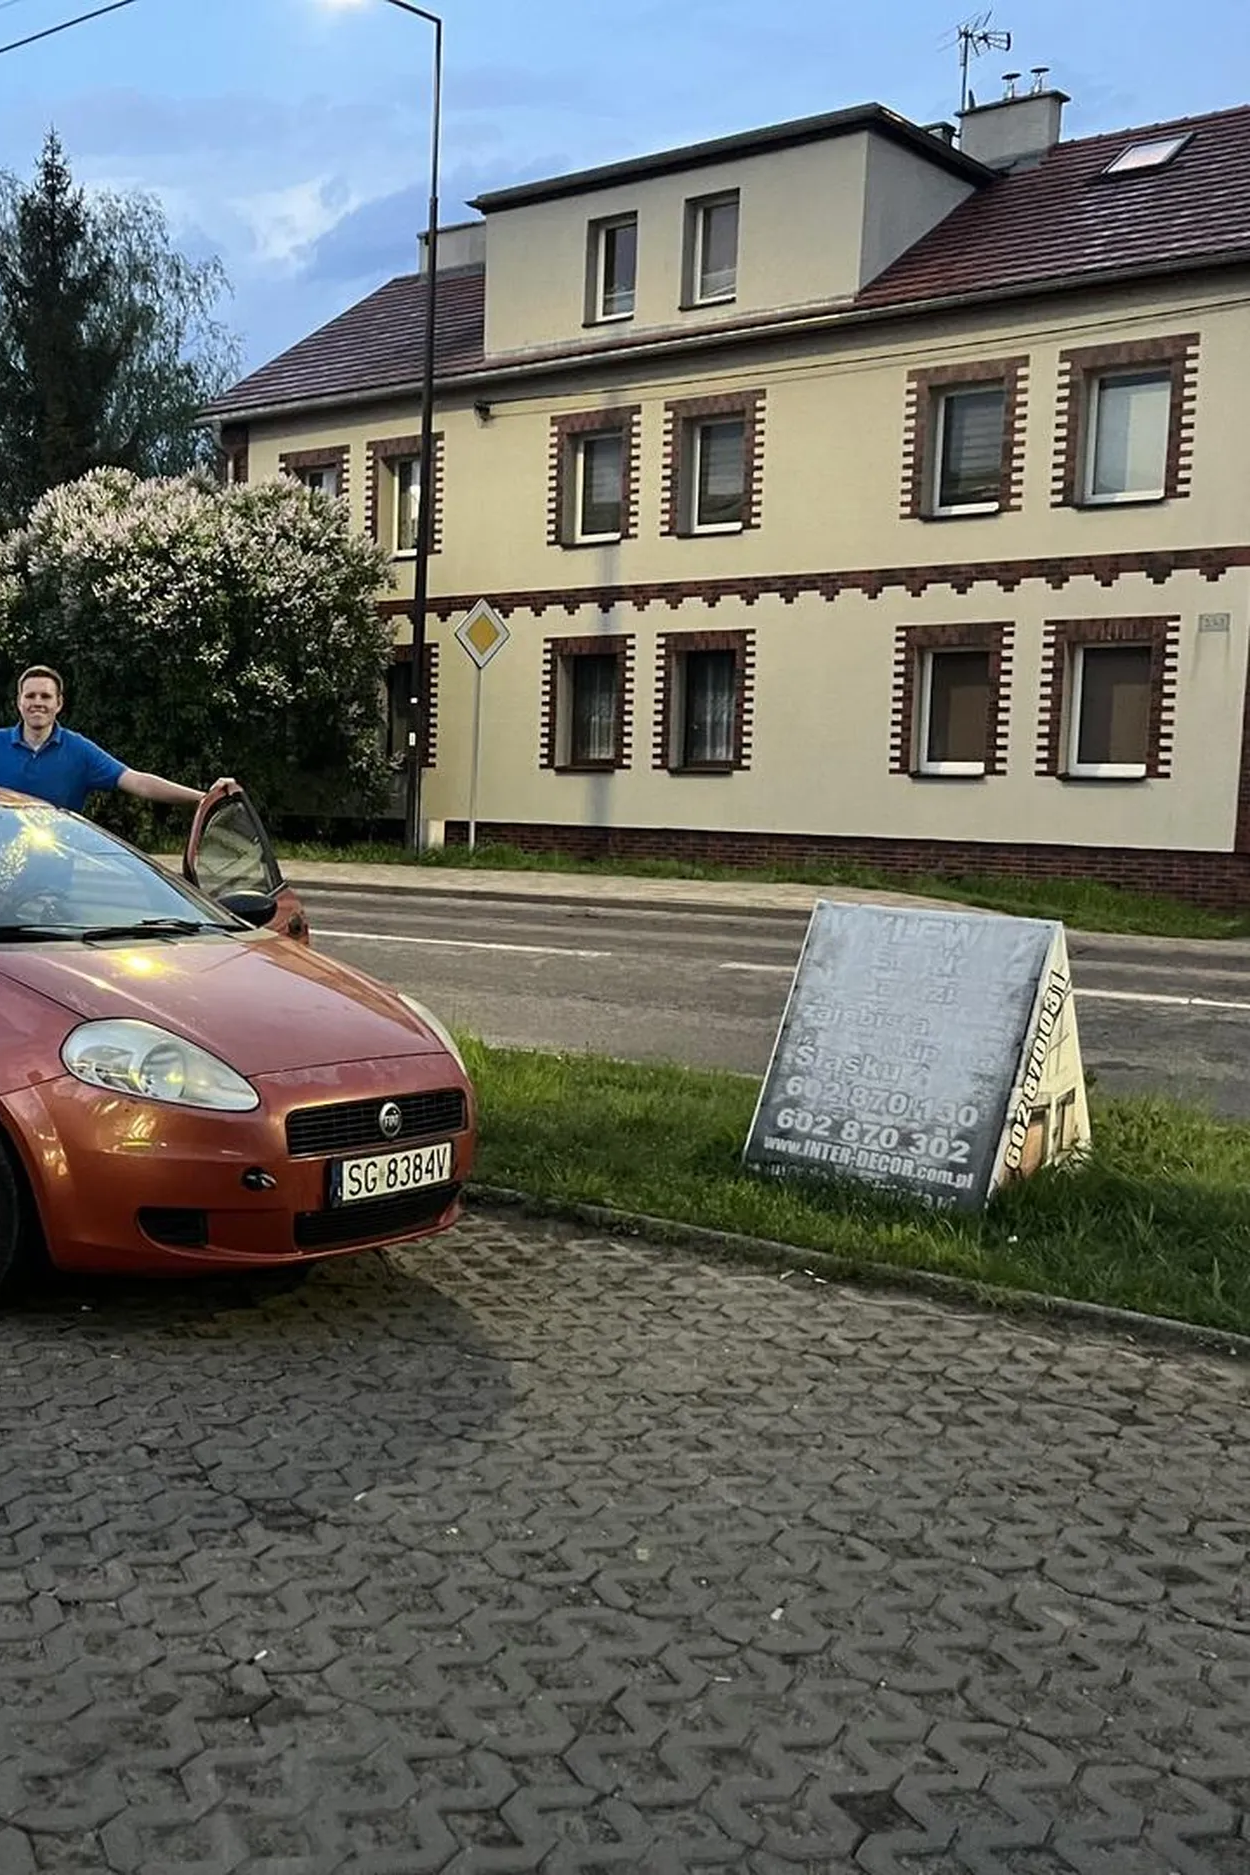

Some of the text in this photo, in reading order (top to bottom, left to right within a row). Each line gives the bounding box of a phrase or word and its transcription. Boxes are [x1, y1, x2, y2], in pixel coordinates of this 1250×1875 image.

[786, 1076, 842, 1101] 602
[850, 1086, 910, 1115] 870
[1004, 1099, 1033, 1171] 602
[1022, 1035, 1048, 1102] 870
[763, 1135, 975, 1189] www.INTER-DECOR.com.pl
[776, 1108, 971, 1164] 602 870 302
[348, 1147, 448, 1196] SG 8384V
